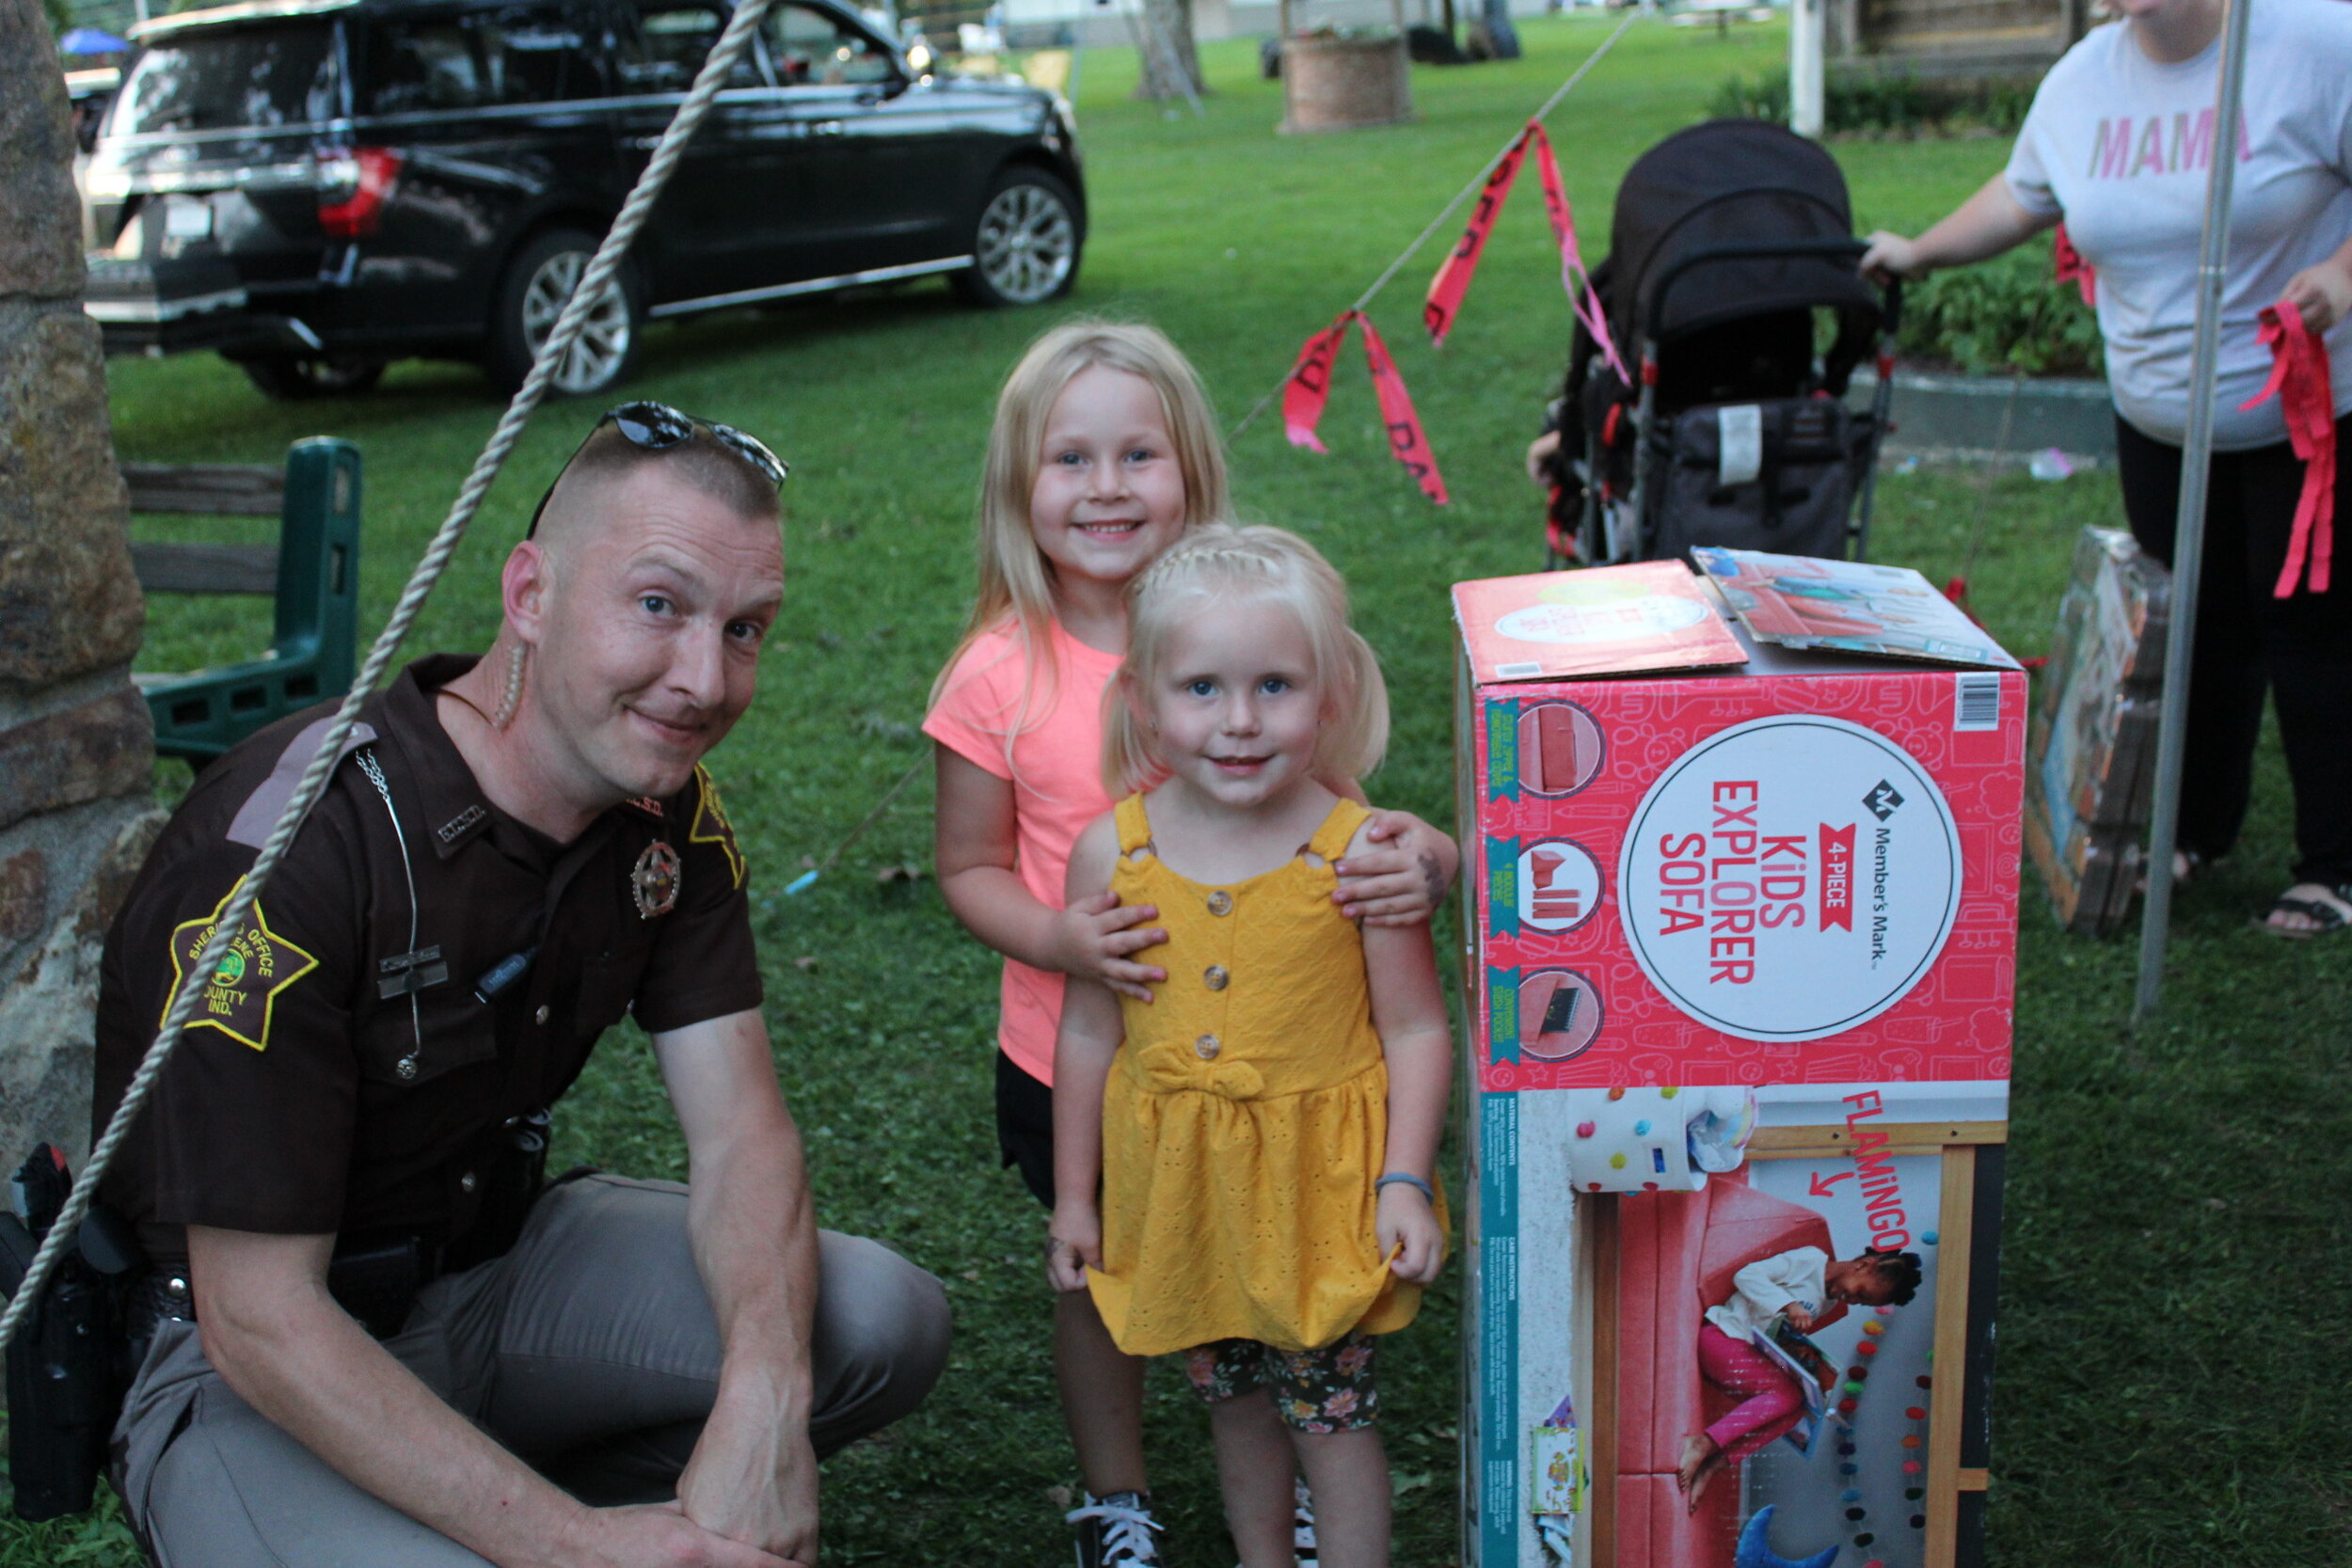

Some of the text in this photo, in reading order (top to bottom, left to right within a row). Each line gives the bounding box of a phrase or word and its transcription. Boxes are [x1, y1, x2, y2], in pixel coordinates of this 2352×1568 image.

[1660, 832, 1707, 936] SOFA
[1709, 780, 1758, 985] EXPLORER
[1826, 841, 1848, 909] 4-PIECE
[1873, 828, 1890, 911] Member's
[247, 928, 275, 978] OFFICE
[1871, 916, 1887, 960] Mark
[208, 999, 233, 1016] IND.
[1842, 1090, 1911, 1253] FLAMiNGO
